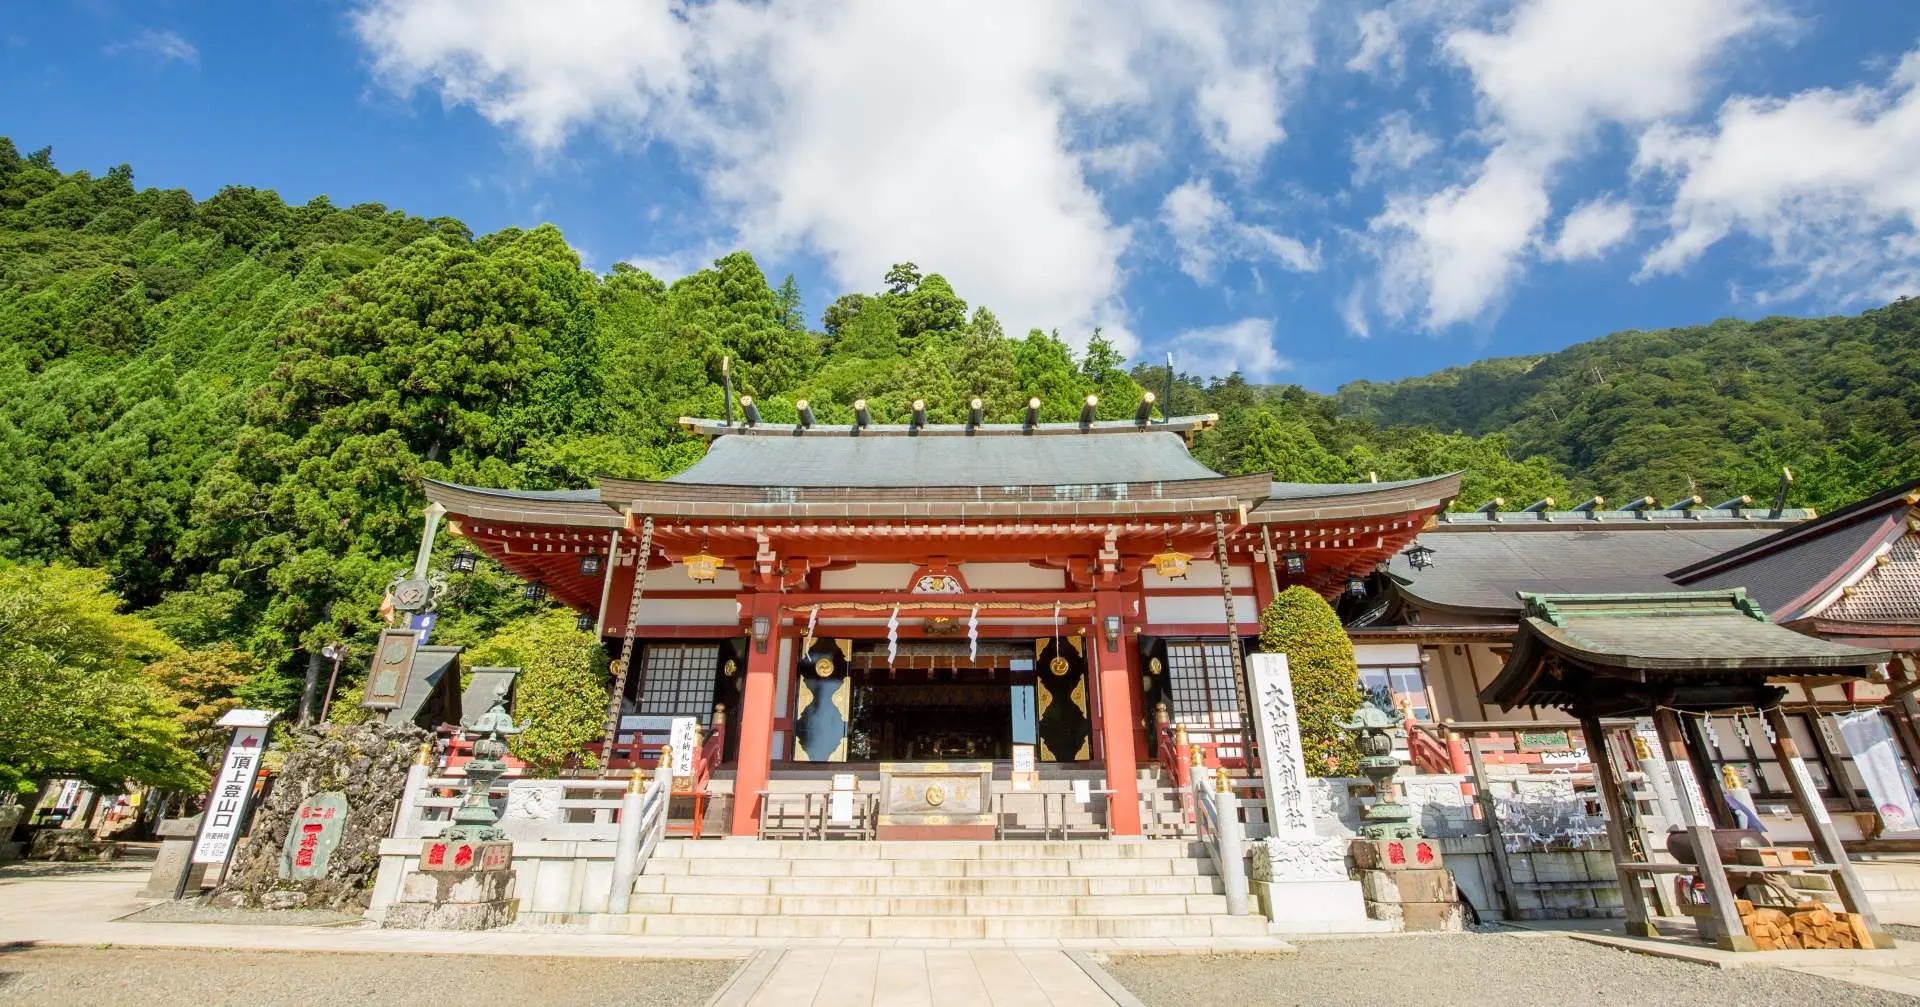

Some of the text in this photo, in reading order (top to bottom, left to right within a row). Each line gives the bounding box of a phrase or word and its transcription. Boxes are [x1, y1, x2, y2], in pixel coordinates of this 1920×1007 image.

[213, 756, 252, 827] 頂上登山口
